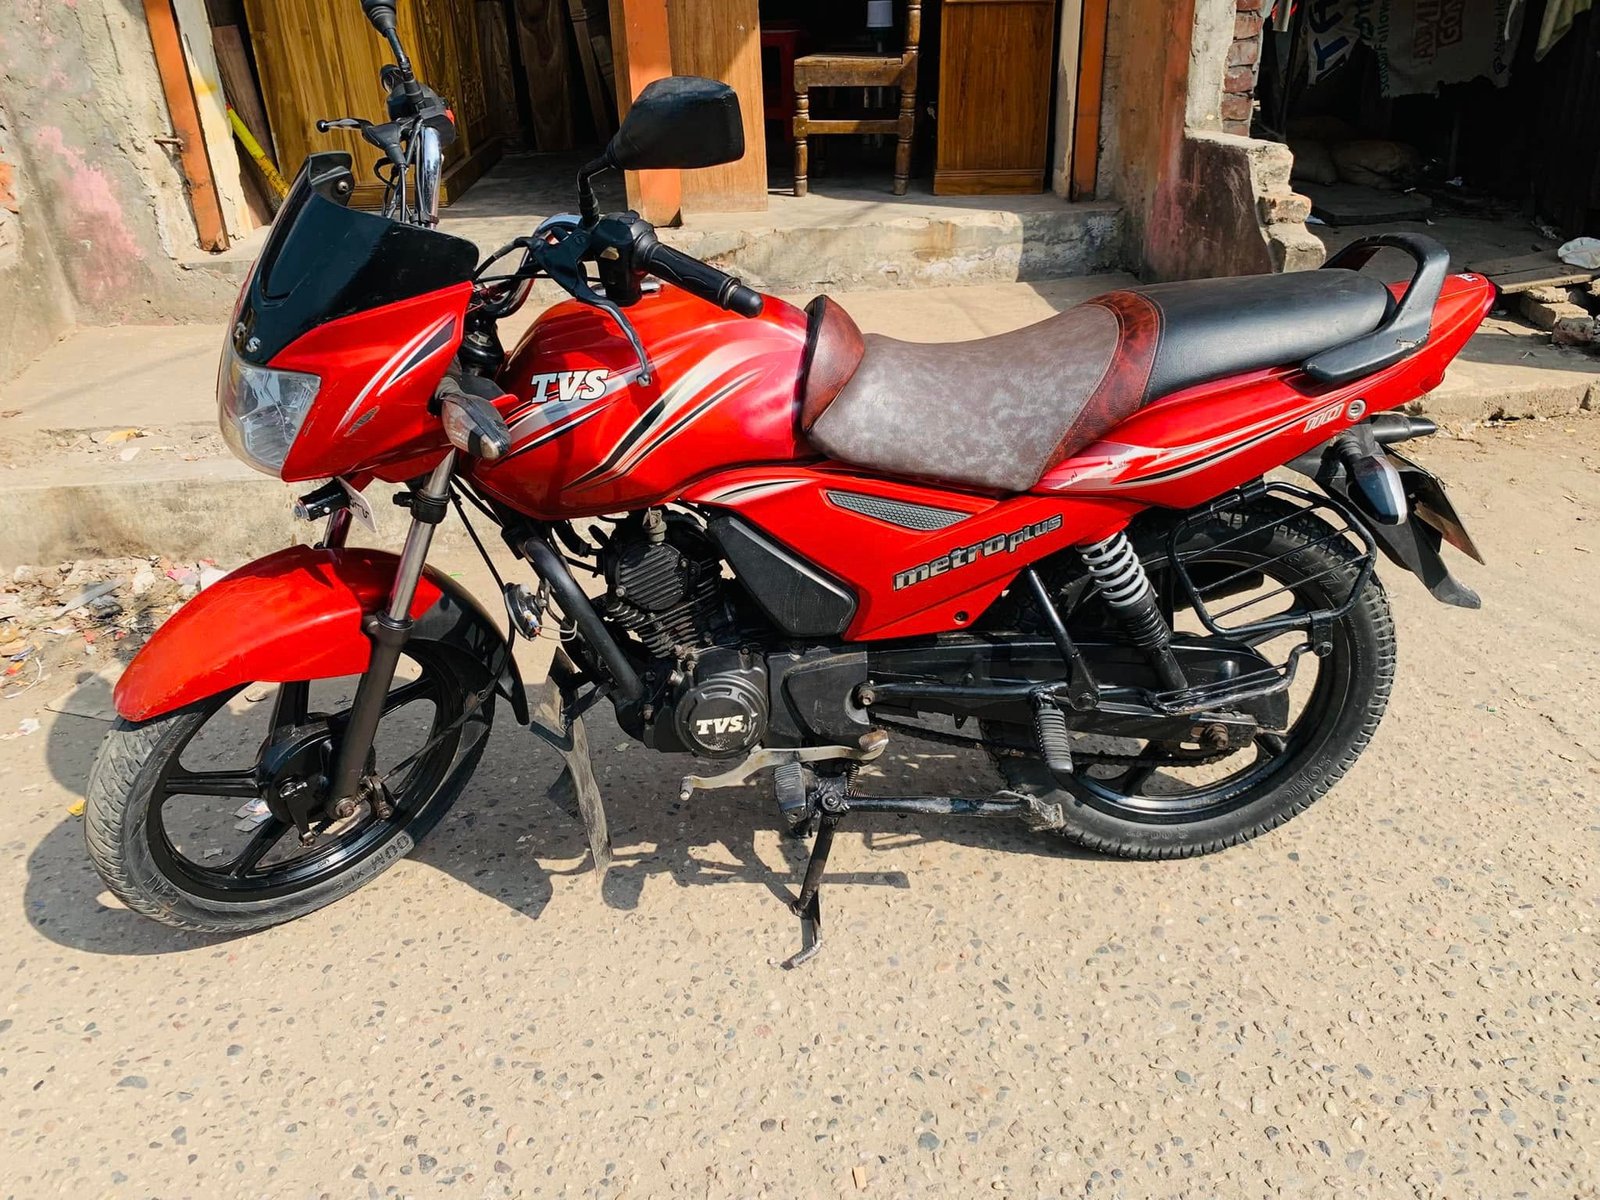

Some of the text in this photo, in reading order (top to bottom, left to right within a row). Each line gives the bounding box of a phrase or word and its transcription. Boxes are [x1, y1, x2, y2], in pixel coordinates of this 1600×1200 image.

[531, 368, 610, 404] TVS
[894, 514, 1063, 591] metro plus
[696, 715, 744, 735] TVS
